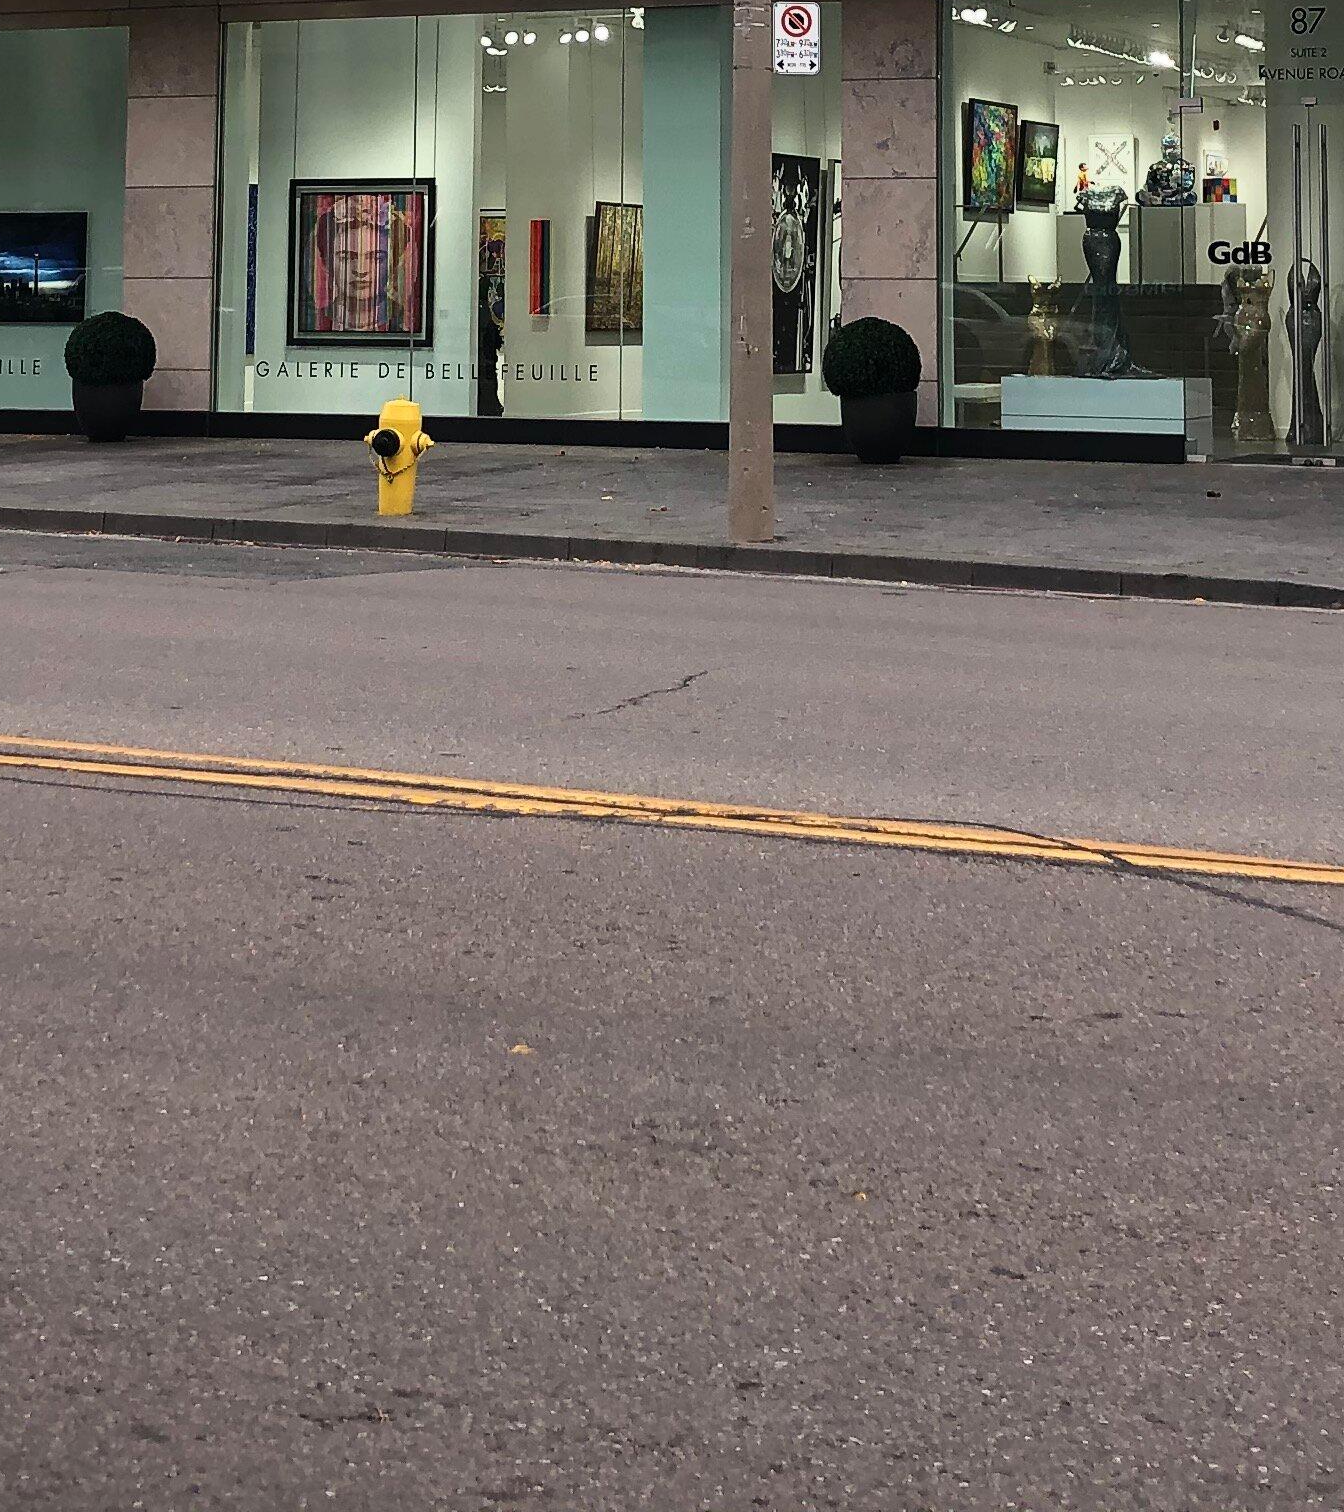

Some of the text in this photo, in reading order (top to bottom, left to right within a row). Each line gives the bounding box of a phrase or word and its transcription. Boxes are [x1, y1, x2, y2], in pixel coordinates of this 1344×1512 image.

[1291, 7, 1326, 35] 87
[1290, 48, 1327, 58] SUITE 2
[1259, 67, 1313, 80] AVENUE
[1207, 241, 1272, 265] GdB
[256, 361, 598, 381] GALERIE DE BELLFEUILLE
